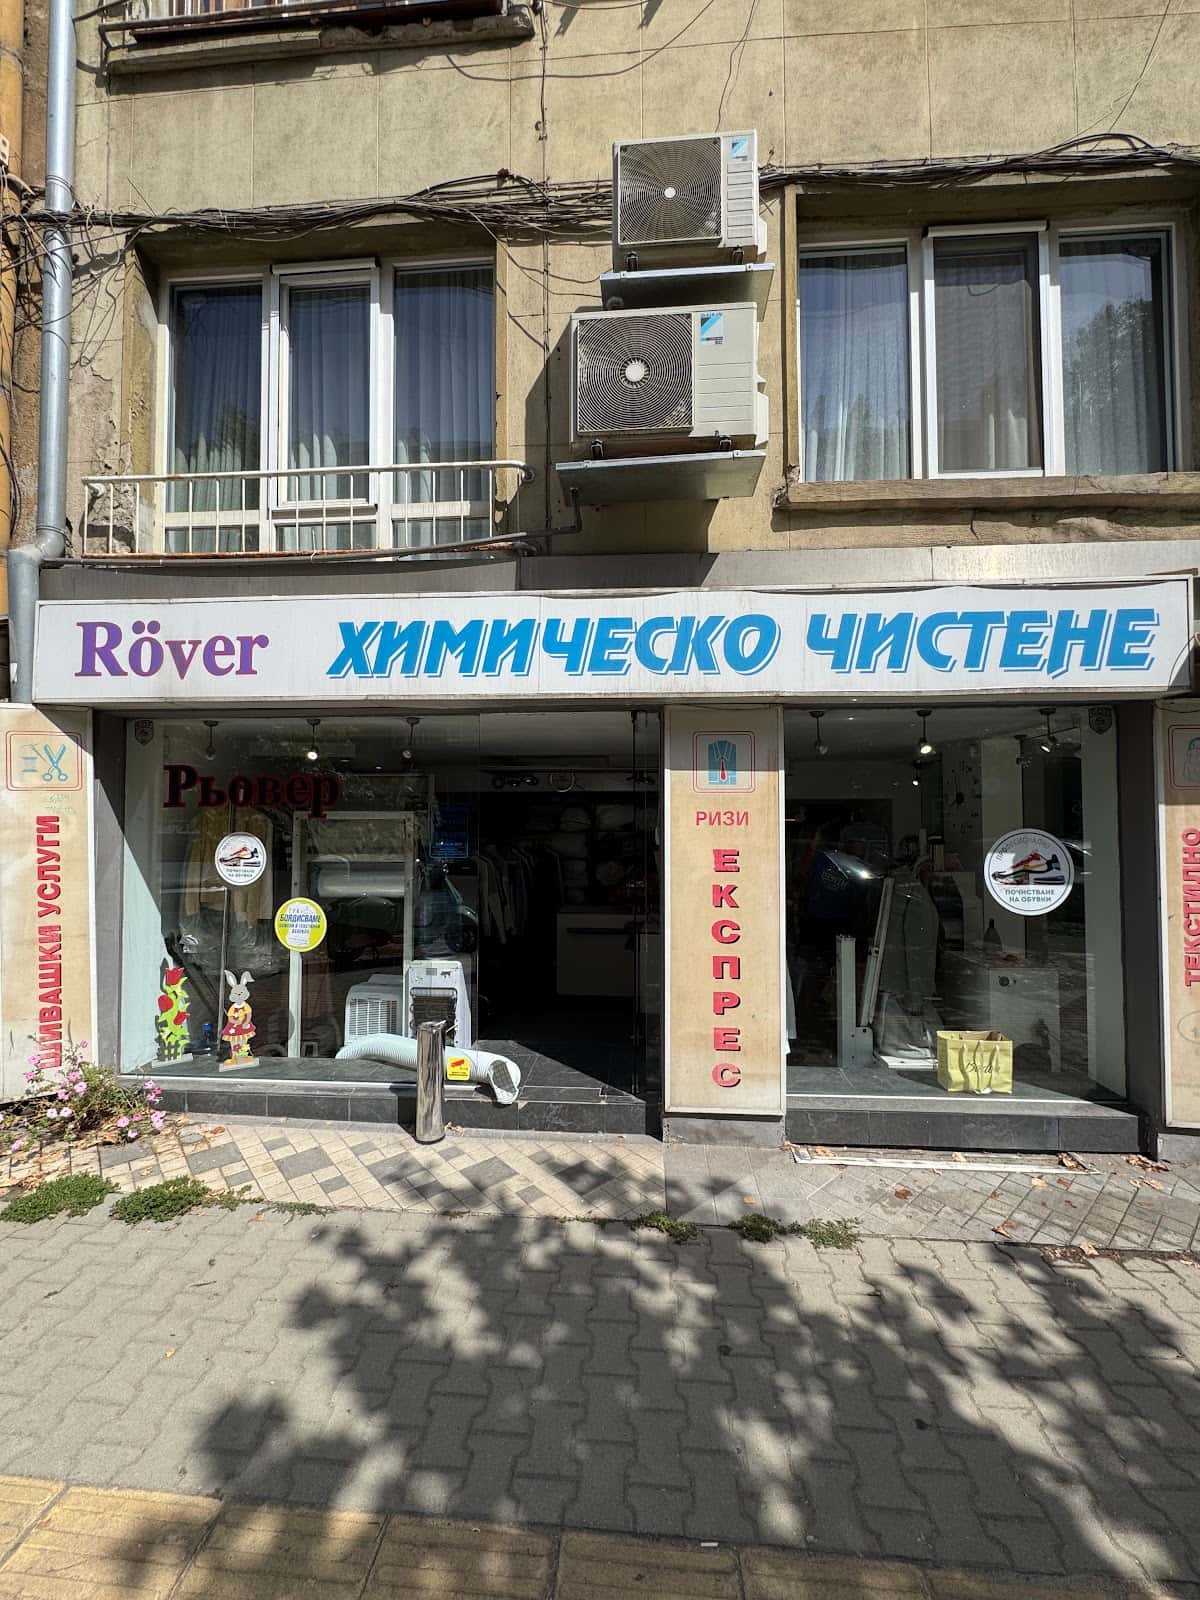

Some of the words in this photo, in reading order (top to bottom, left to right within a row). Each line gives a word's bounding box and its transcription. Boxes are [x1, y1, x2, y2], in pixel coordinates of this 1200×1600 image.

[75, 620, 269, 680] Röver
[325, 613, 781, 679] ХИМИЧЕСКО
[806, 608, 1160, 679] ЧИСТЕНЕ
[162, 764, 341, 819] Рьовер
[695, 810, 750, 827] РИЗИ
[36, 815, 62, 919] УСЛУГИ
[1182, 827, 1200, 987] ТЕКСТИЛНО
[37, 924, 62, 1070] ШИВАШКИ
[711, 848, 741, 1088] ЕКСПРЕС
